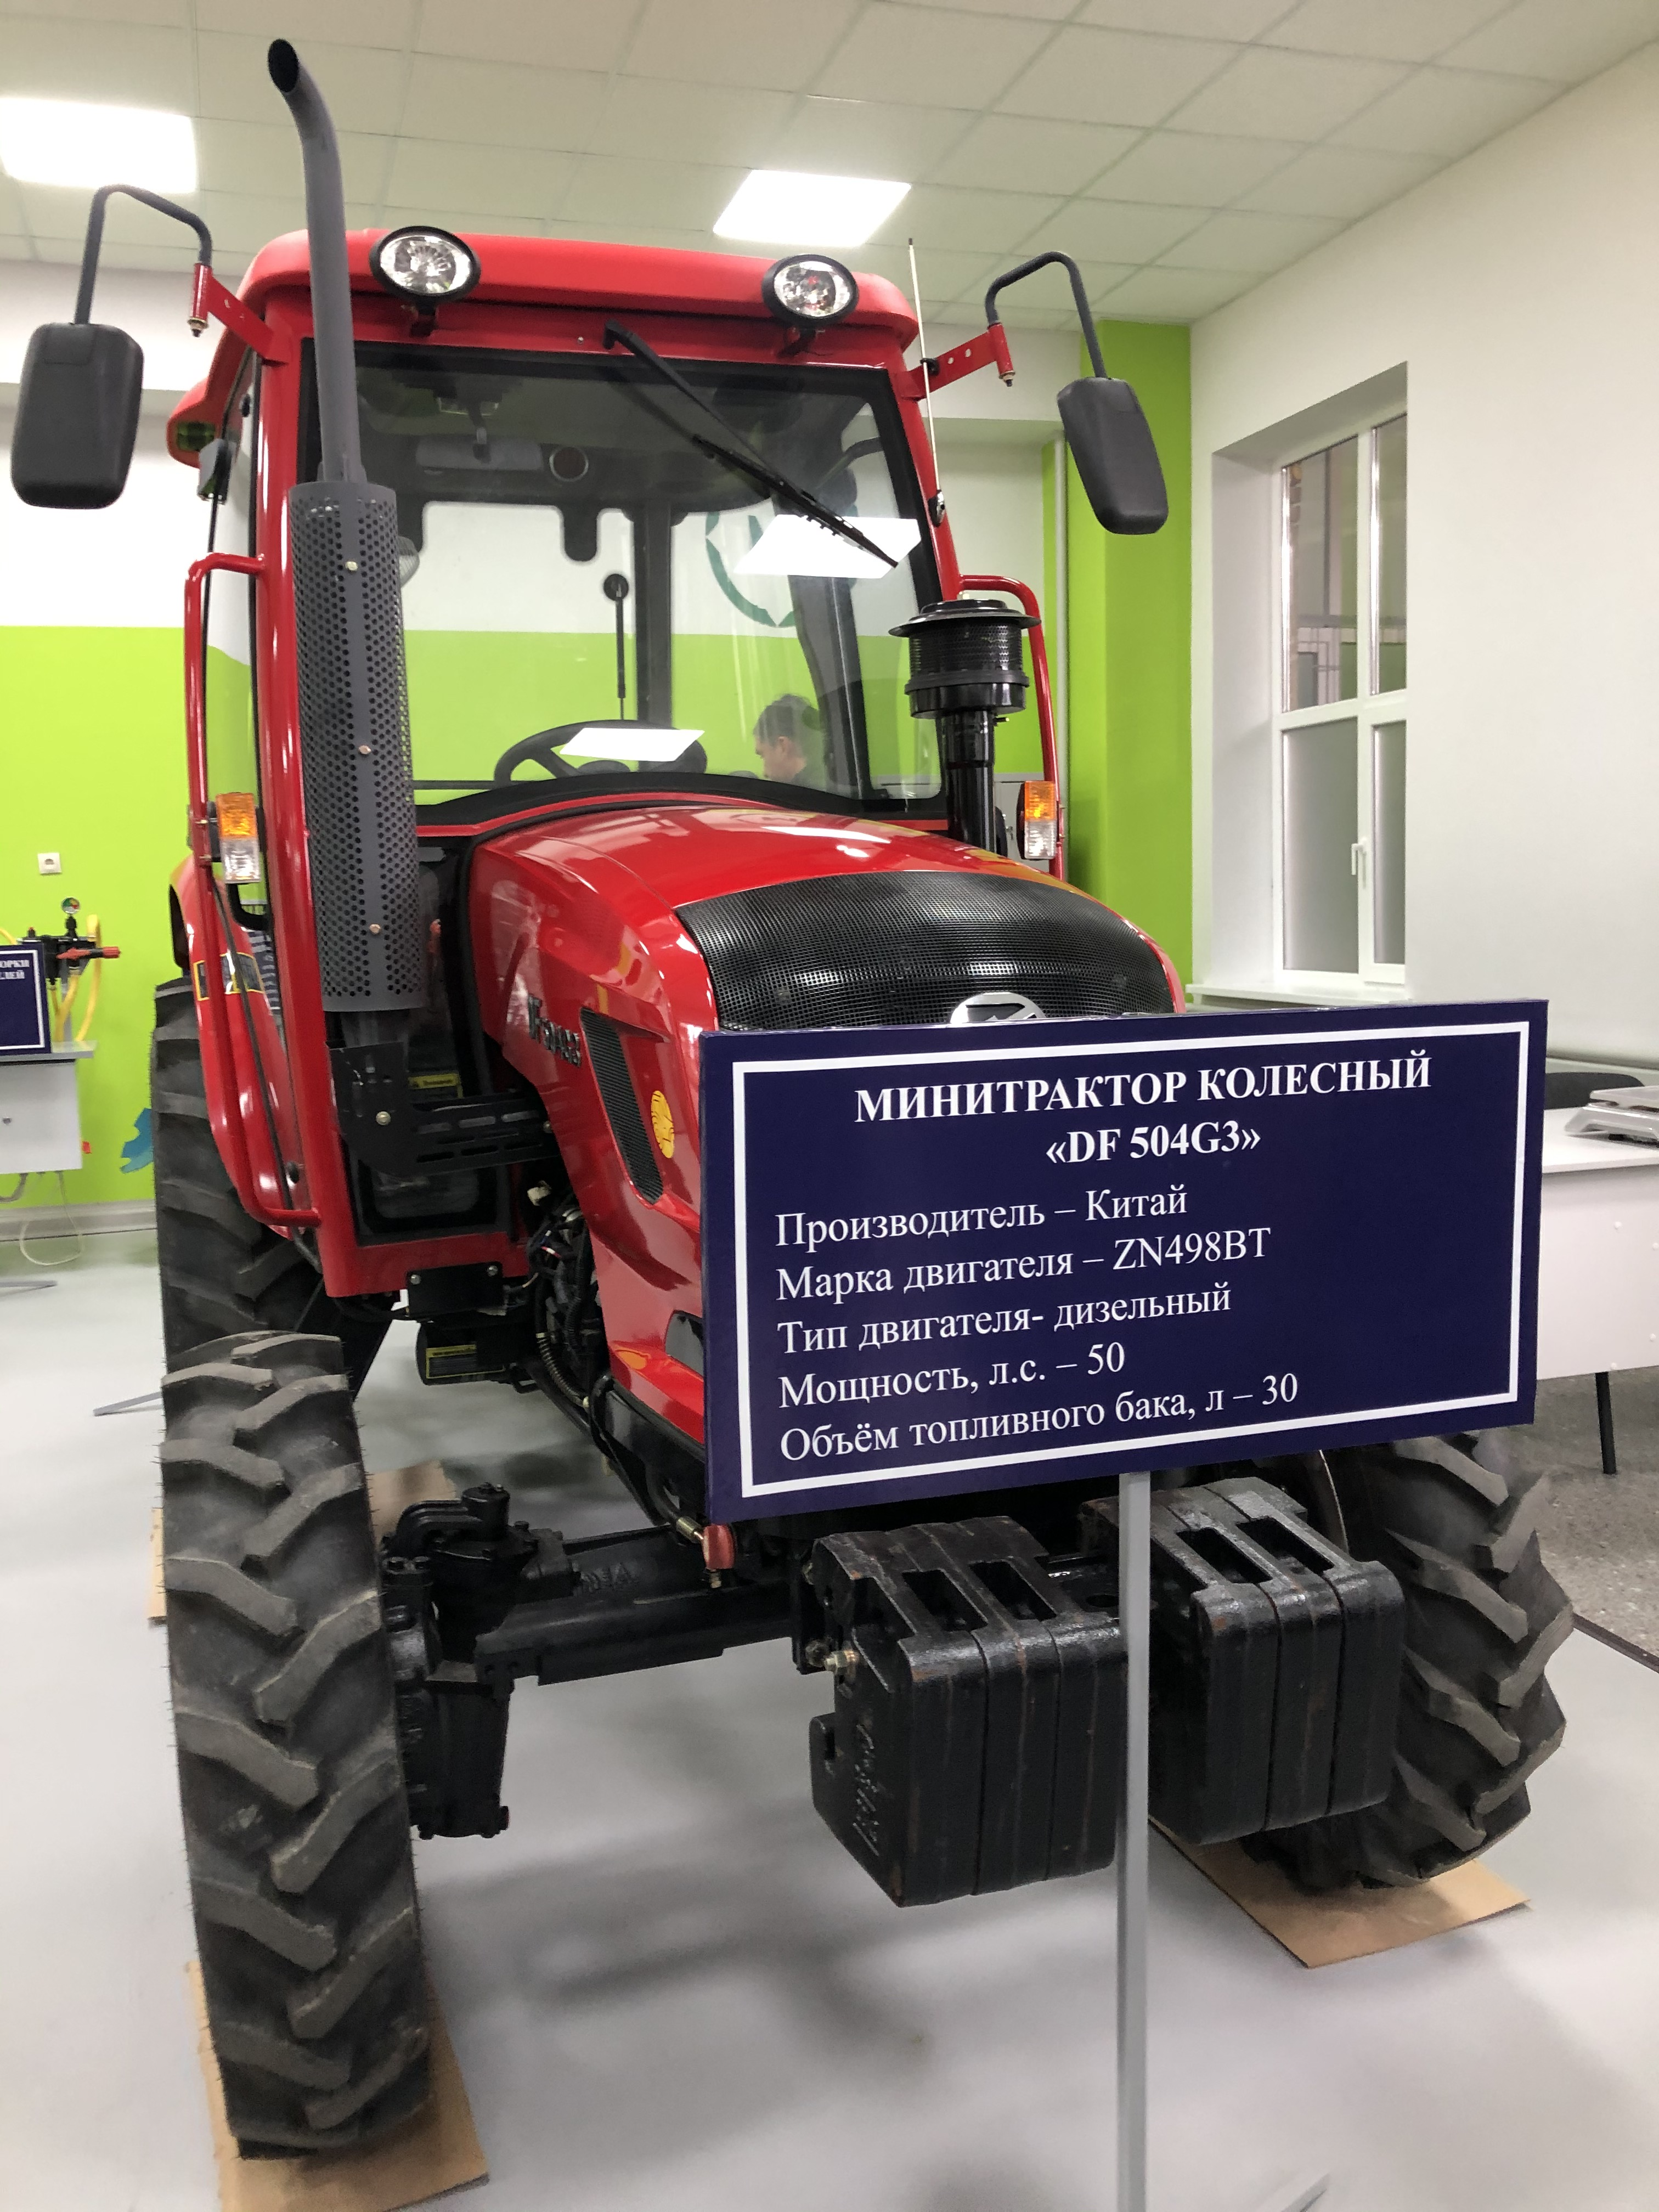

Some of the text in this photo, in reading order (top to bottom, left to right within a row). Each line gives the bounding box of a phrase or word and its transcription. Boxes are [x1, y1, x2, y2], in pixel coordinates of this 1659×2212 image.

[854, 1049, 1432, 1122] МИНИТРАКТОР КОЛЕСНЫЙ
[1046, 1120, 1261, 1164] «DF 504G3»
[775, 1204, 1045, 1253] Производитель
[1085, 1183, 1188, 1221] Китай
[776, 1266, 894, 1305] Марка
[903, 1253, 1074, 1294] двигателя
[1113, 1227, 1271, 1270] ZN498BT
[777, 1281, 1231, 1354] Тип двигателя- дизельный
[778, 1367, 979, 1408] Мощность,
[989, 1360, 1045, 1385] л.с.
[1087, 1342, 1125, 1375] 50
[781, 1423, 899, 1461] Объём
[909, 1404, 1105, 1446] топливного
[1115, 1390, 1195, 1422] бака,
[1205, 1390, 1224, 1412] л
[1262, 1373, 1297, 1405] 30
